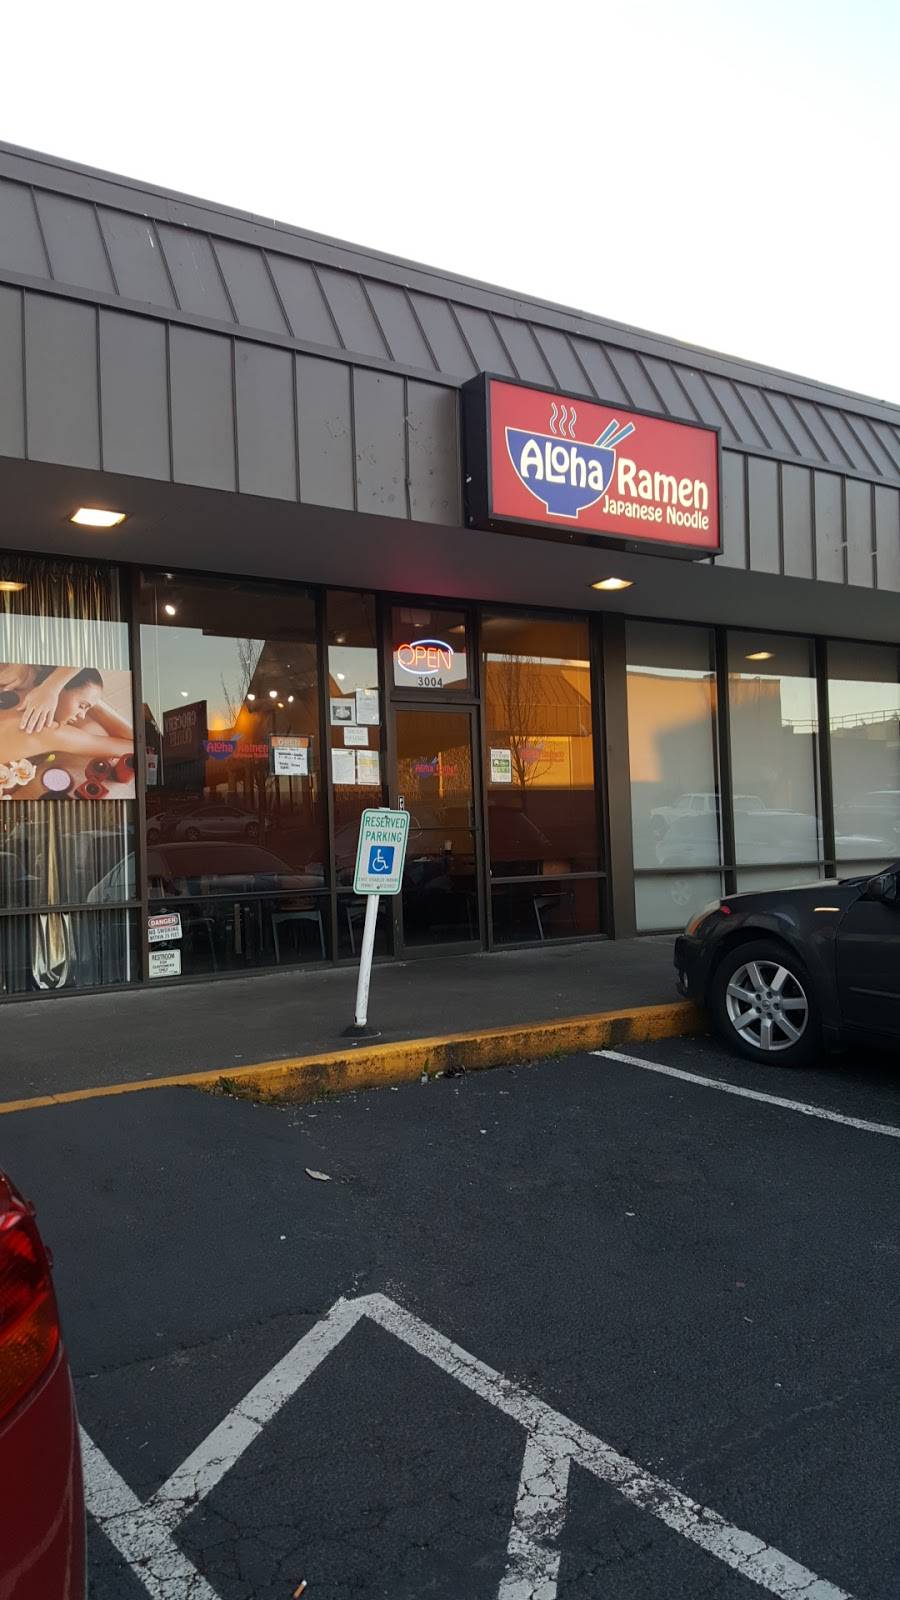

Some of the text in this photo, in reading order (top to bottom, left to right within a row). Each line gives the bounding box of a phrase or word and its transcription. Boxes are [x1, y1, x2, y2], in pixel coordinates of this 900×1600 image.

[617, 457, 709, 511] Ramen
[602, 494, 709, 531] Japanese Noodle
[397, 643, 452, 670] OPEN
[417, 676, 443, 688] 3004
[364, 815, 406, 829] RESERVED
[365, 831, 402, 843] PARKING
[150, 917, 176, 926] DANGER
[151, 953, 175, 961] RESTROOM
